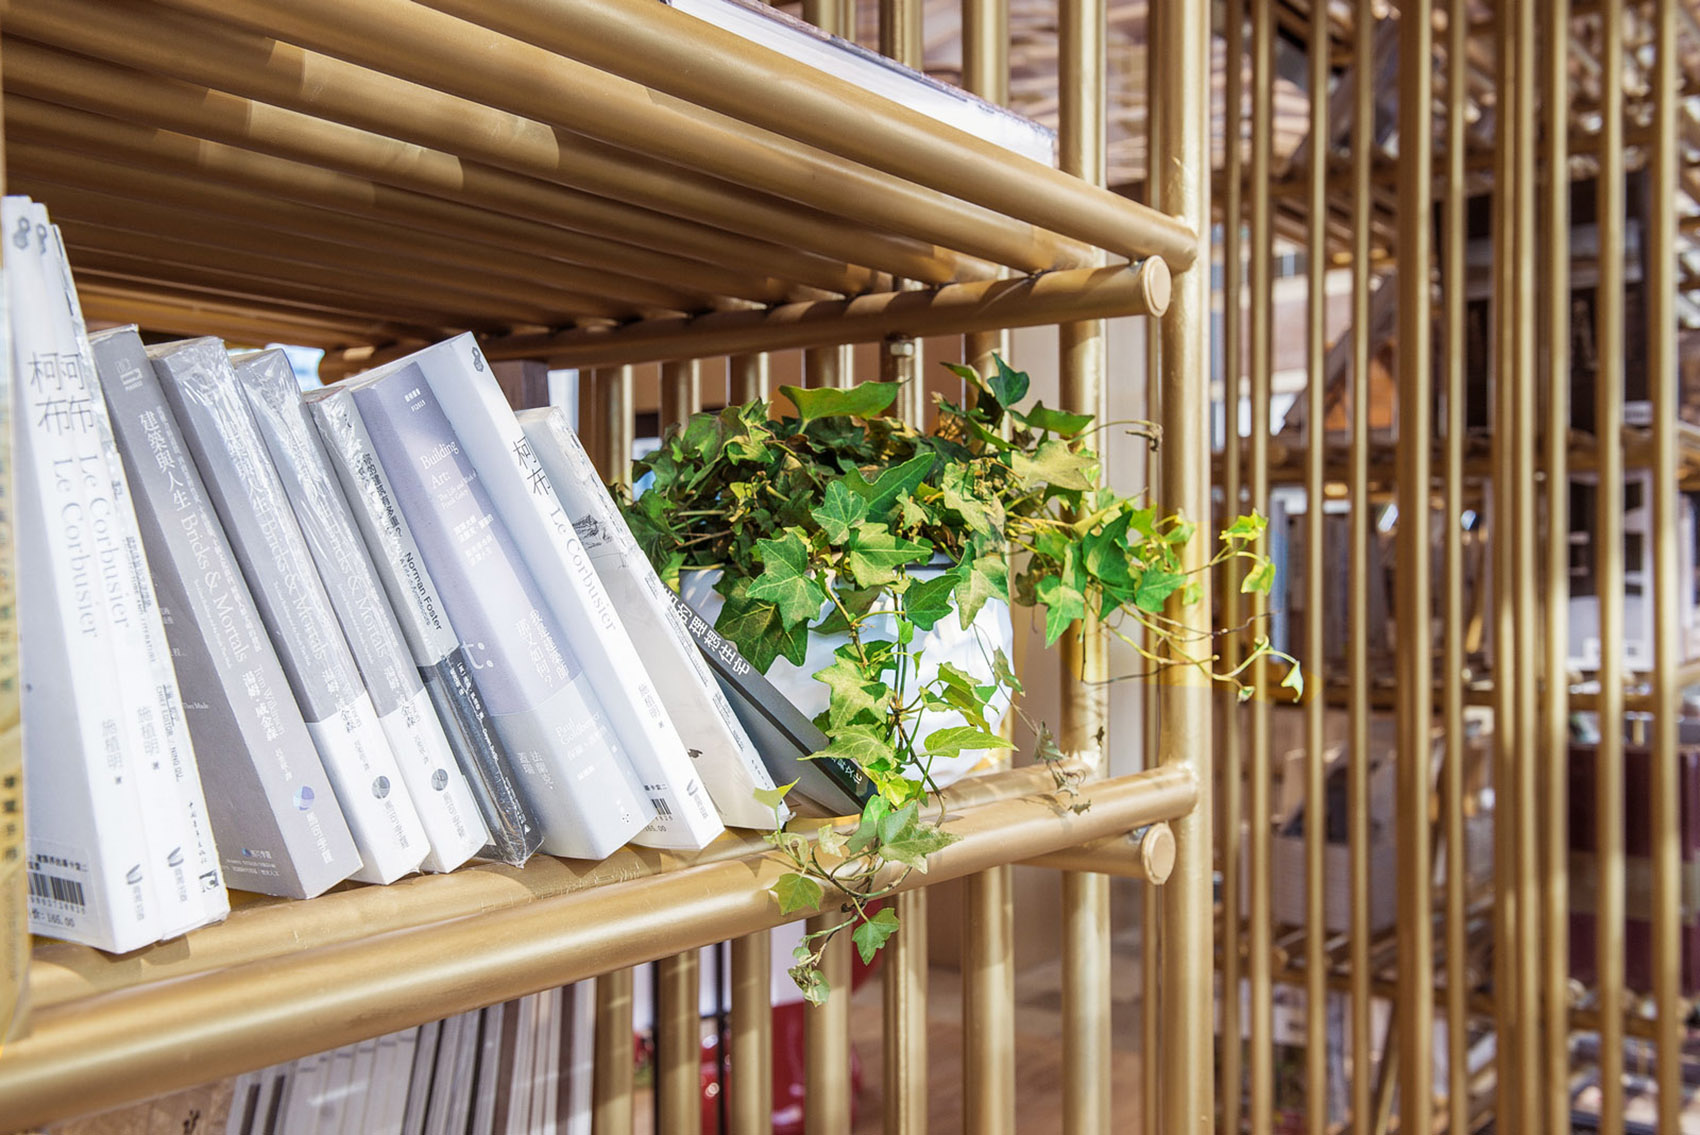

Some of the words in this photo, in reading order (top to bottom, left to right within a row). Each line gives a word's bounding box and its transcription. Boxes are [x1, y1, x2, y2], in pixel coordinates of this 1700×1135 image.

[52, 459, 73, 492] Le
[79, 454, 99, 487] Le
[420, 441, 460, 469] Building
[431, 471, 451, 489] Art:
[512, 436, 550, 496] 柯布
[60, 501, 98, 638] Corbusier
[88, 496, 131, 629] Corbusier
[179, 514, 209, 570] Bricks
[205, 571, 221, 594] &
[213, 593, 250, 663] Mortals
[260, 517, 289, 573] Bricks
[284, 572, 299, 595] &
[293, 594, 327, 660] Mortals
[405, 551, 426, 596] Norman
[424, 596, 443, 631] Foster
[550, 508, 569, 535] Le
[566, 538, 617, 632] Corbusier
[347, 575, 361, 596] &
[356, 595, 390, 658] Mortals
